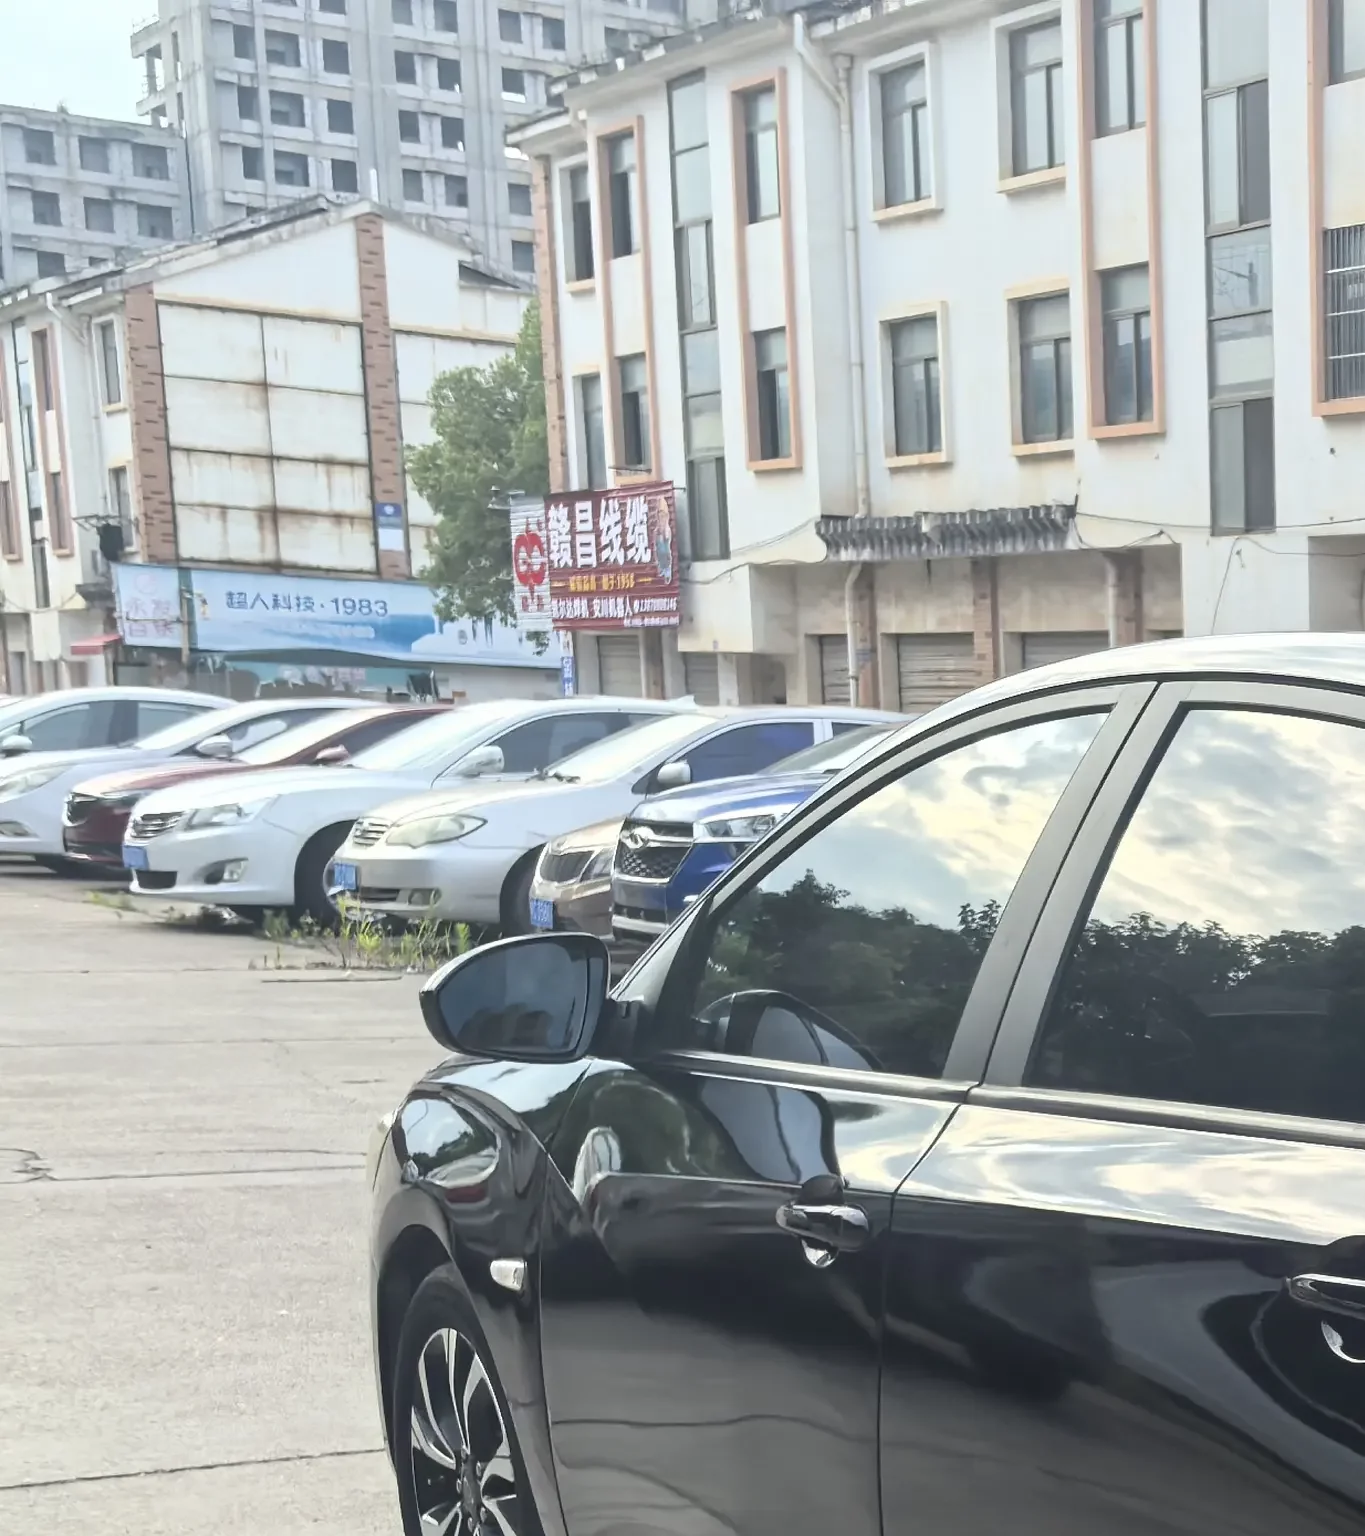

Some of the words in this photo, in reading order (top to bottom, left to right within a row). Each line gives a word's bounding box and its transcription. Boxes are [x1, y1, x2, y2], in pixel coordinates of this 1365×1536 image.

[548, 494, 652, 569] 赣昌线缆
[225, 590, 388, 617] 超人科技·1983
